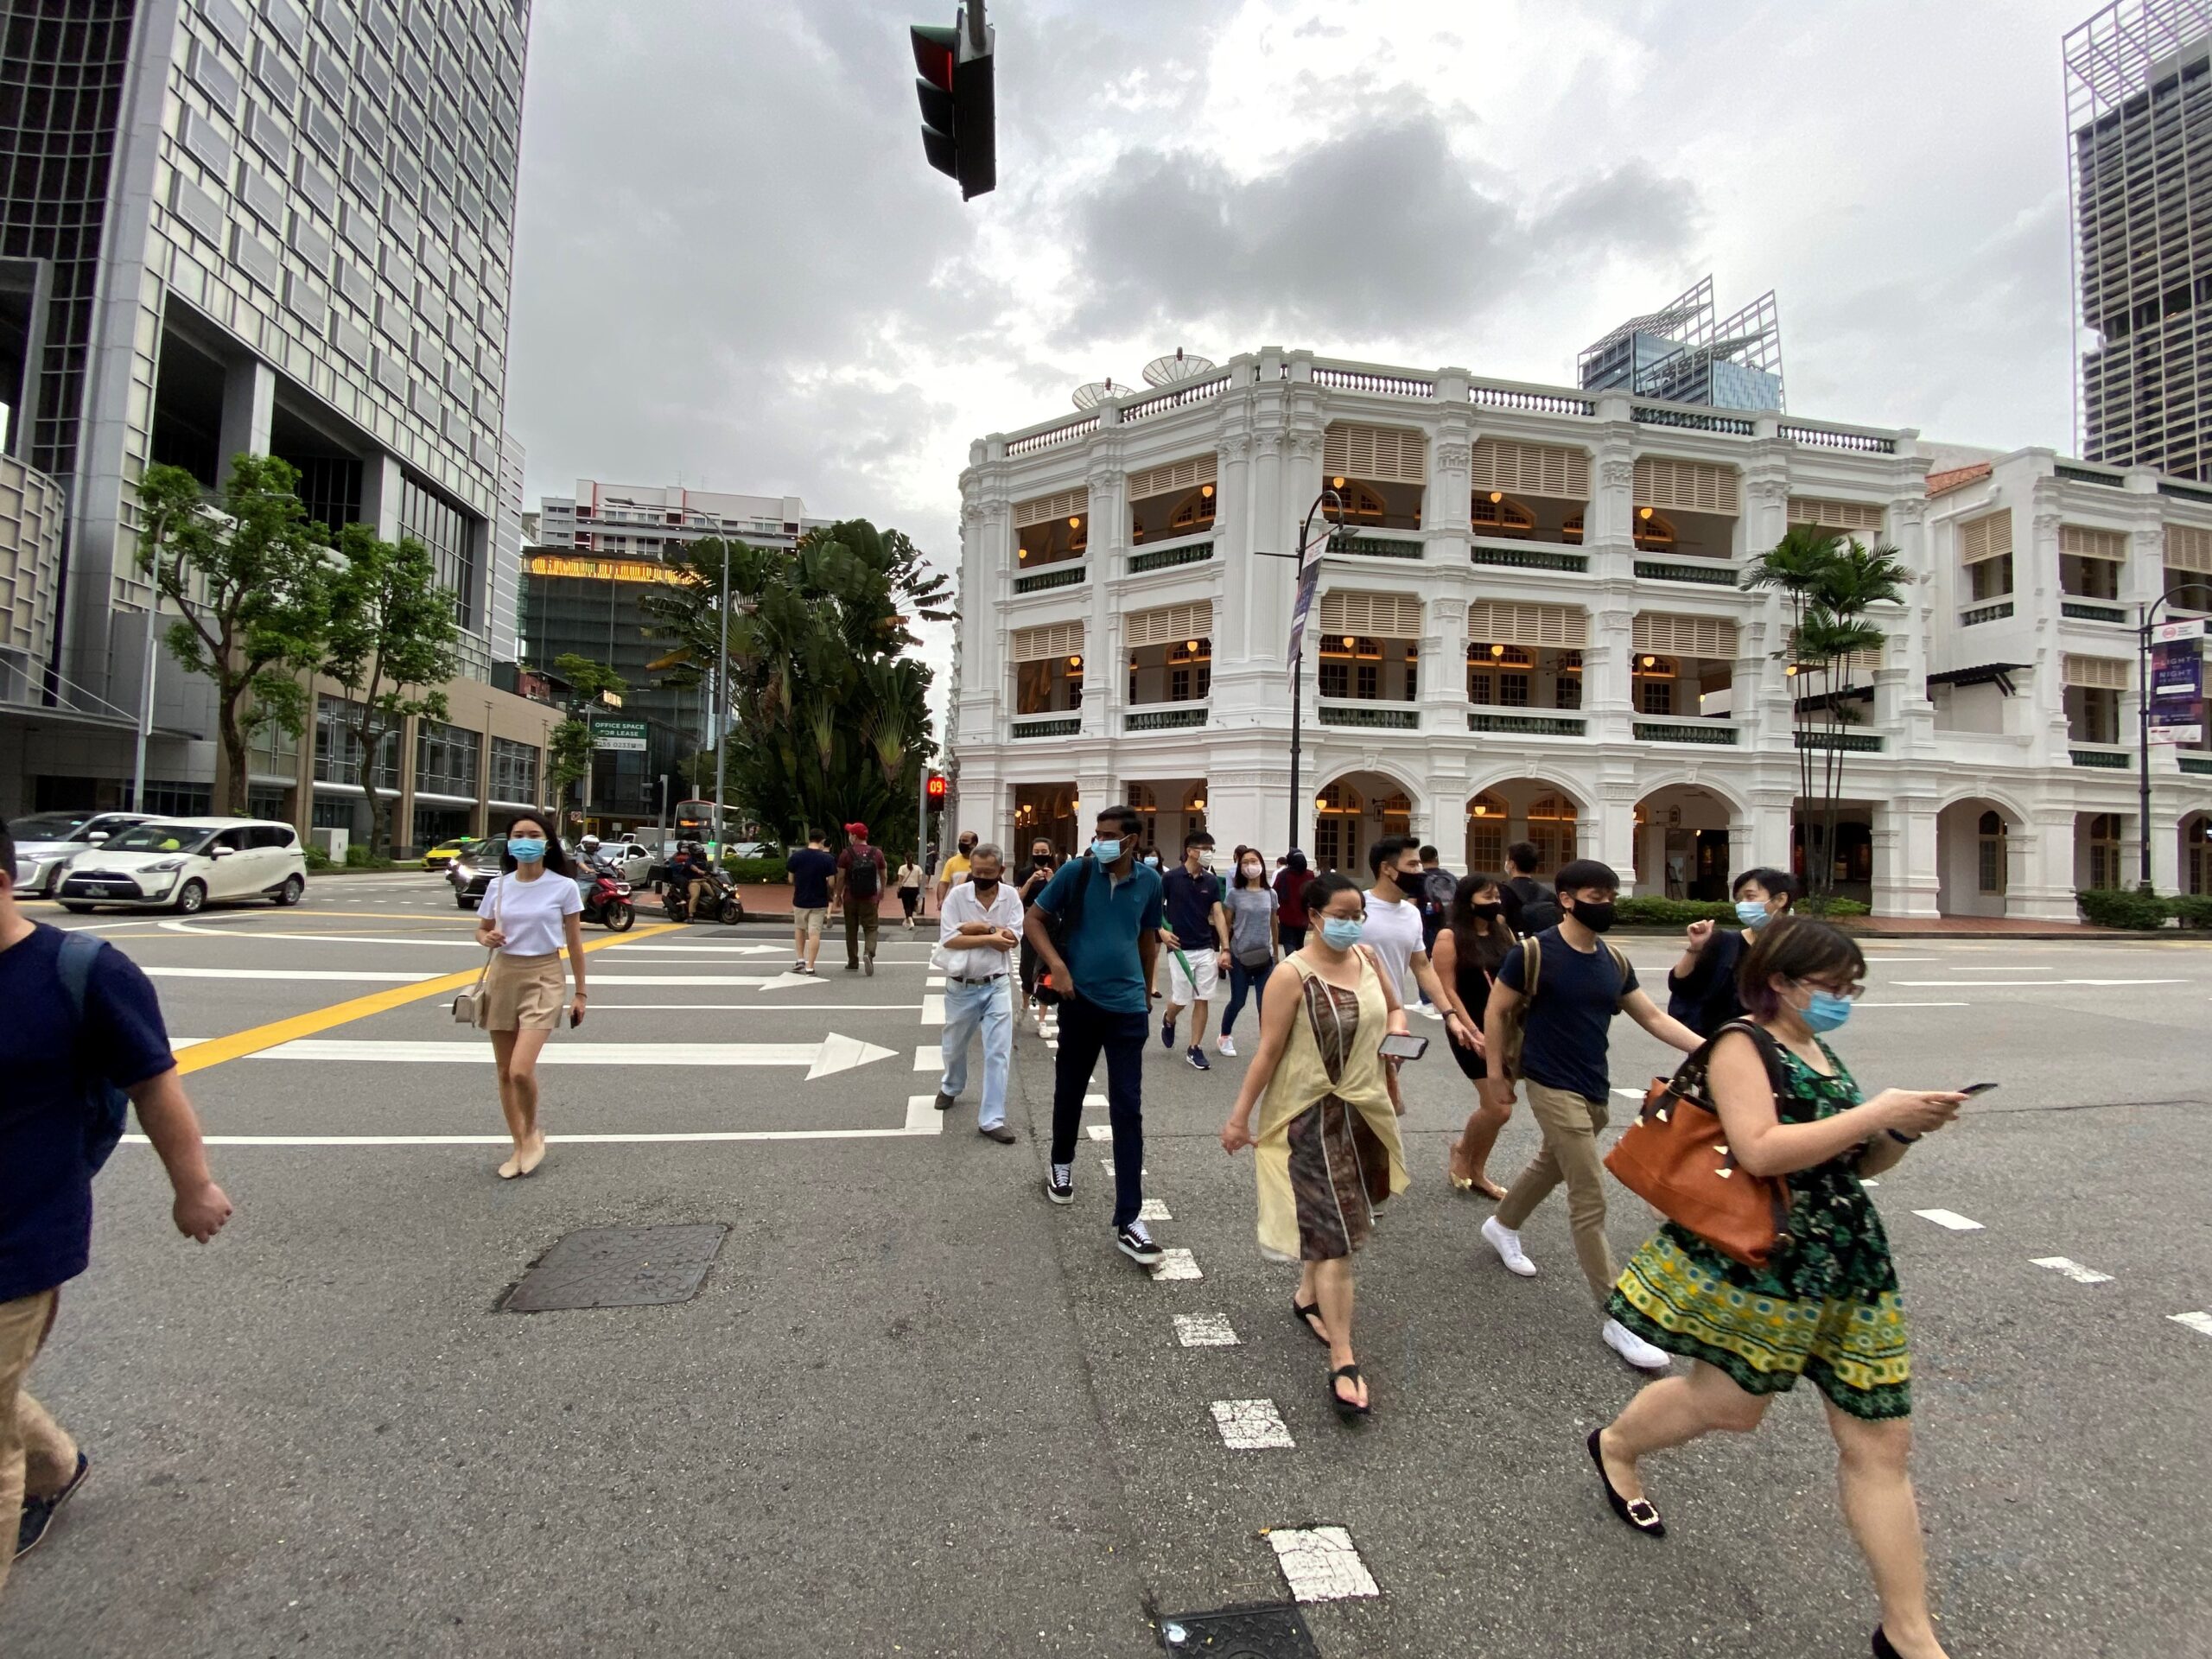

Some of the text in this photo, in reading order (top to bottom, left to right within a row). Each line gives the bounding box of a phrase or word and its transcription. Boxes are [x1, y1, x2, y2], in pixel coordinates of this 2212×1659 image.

[2161, 657, 2191, 665] LIGHT
[2159, 669, 2191, 677] NIGHT
[930, 780, 943, 793] 09
